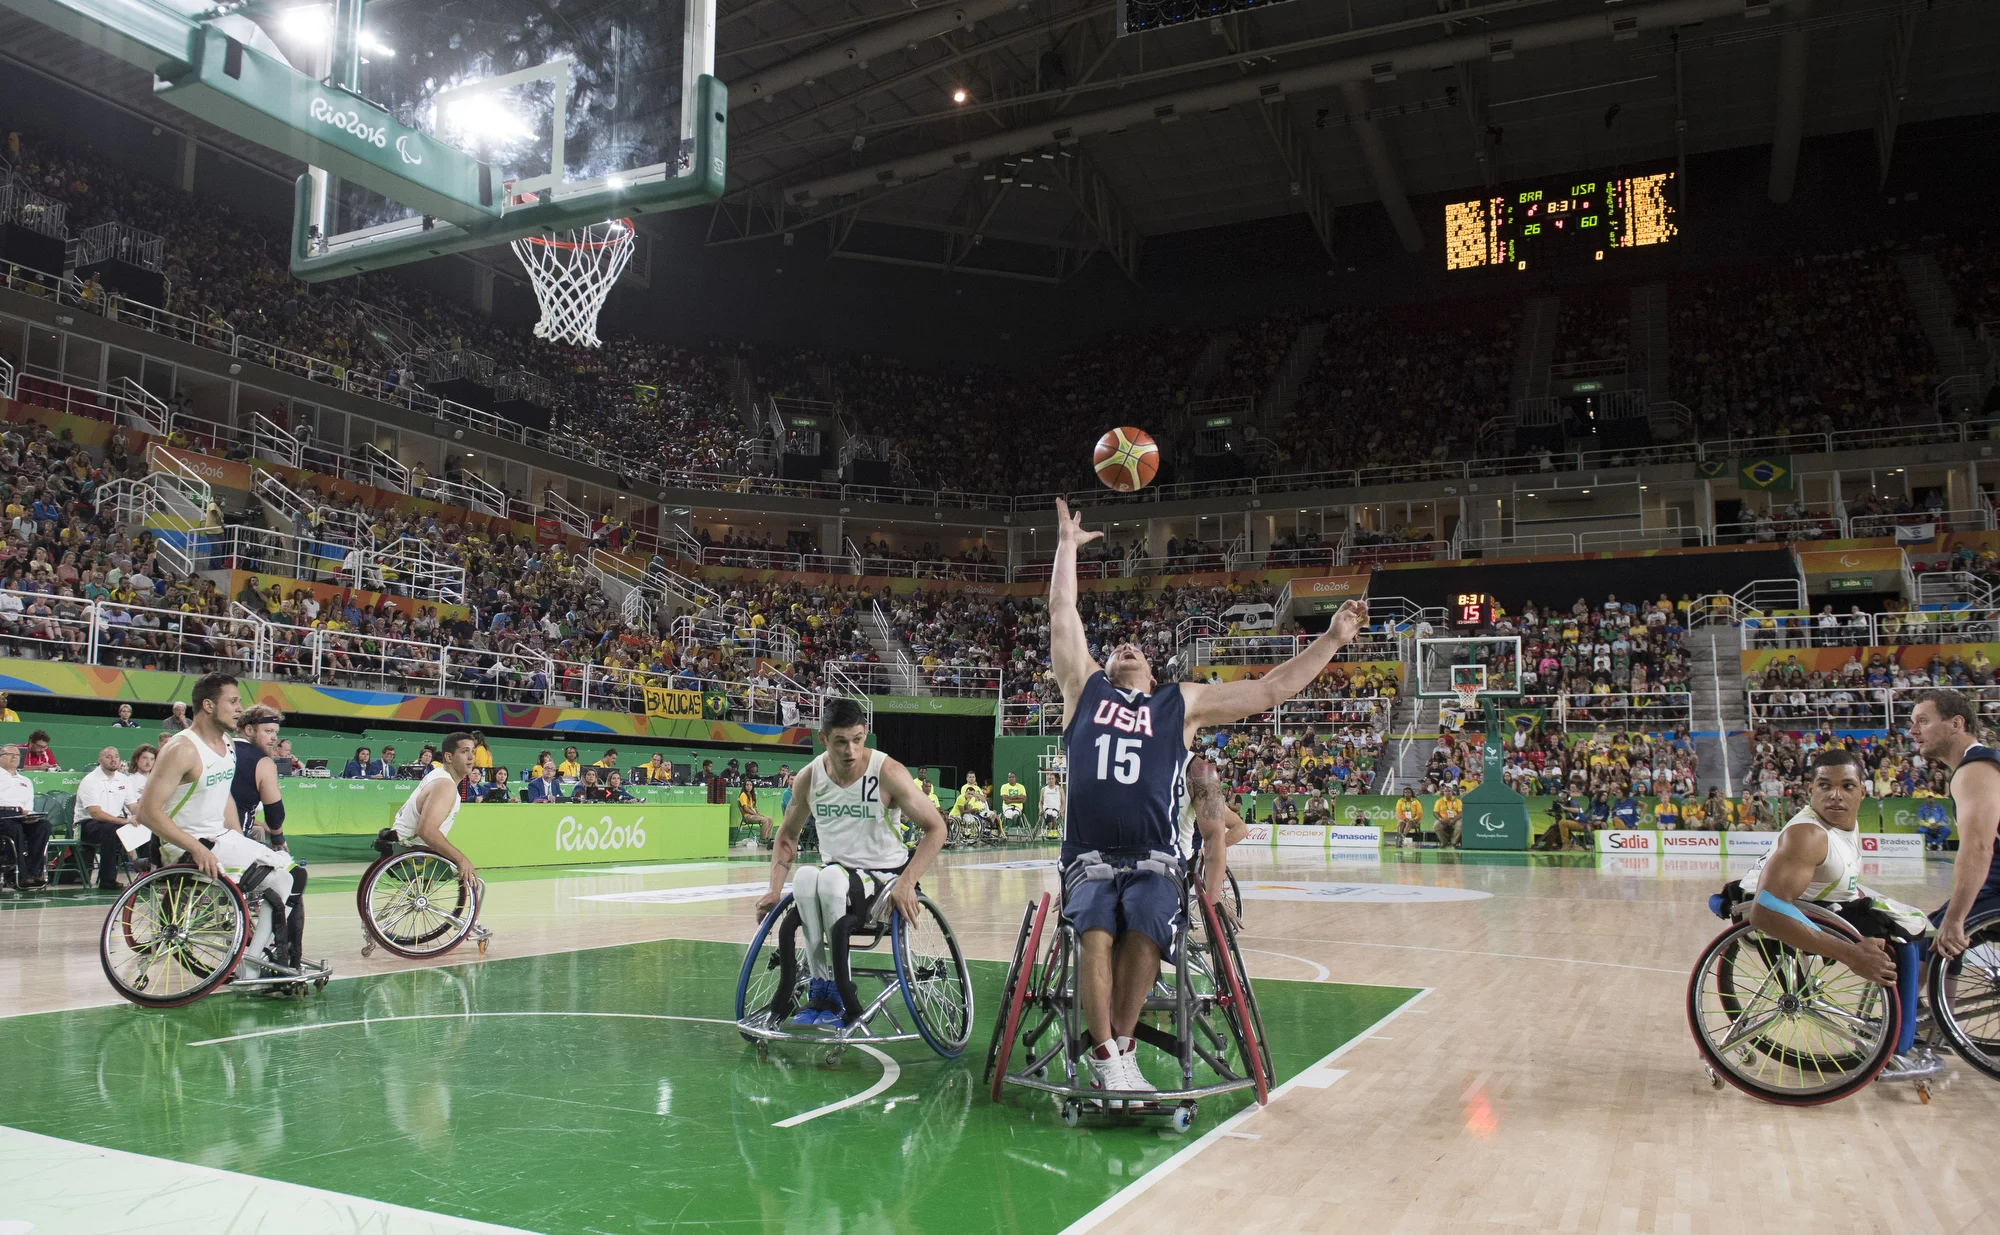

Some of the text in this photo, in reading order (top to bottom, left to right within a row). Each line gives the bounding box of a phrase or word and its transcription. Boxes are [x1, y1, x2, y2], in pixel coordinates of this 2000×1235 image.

[310, 97, 386, 148] Rio2016
[1572, 183, 1595, 196] USA
[1519, 190, 1542, 203] BRA
[1548, 199, 1576, 213] 8:31
[1555, 220, 1563, 228] 4
[1581, 216, 1598, 227] 60
[1524, 224, 1540, 235] 26
[1595, 251, 1603, 260] 0
[1518, 261, 1526, 270] 0
[1313, 581, 1350, 592] Rio2016
[1842, 579, 1861, 587] SAÍDA
[964, 584, 995, 594] Rio2016
[1458, 594, 1484, 605] 8:31
[1463, 605, 1480, 620] 15
[889, 701, 920, 709] Rio2016
[1093, 699, 1154, 738] USA
[1094, 733, 1142, 784] 15
[861, 776, 878, 802] 12
[816, 804, 876, 818] BRASIL
[556, 815, 646, 851] Rio2016
[1279, 829, 1324, 837] Kinoplex
[1331, 832, 1378, 841] Panasonic
[1609, 833, 1644, 849] Sadia
[1664, 837, 1719, 846] NISSAN
